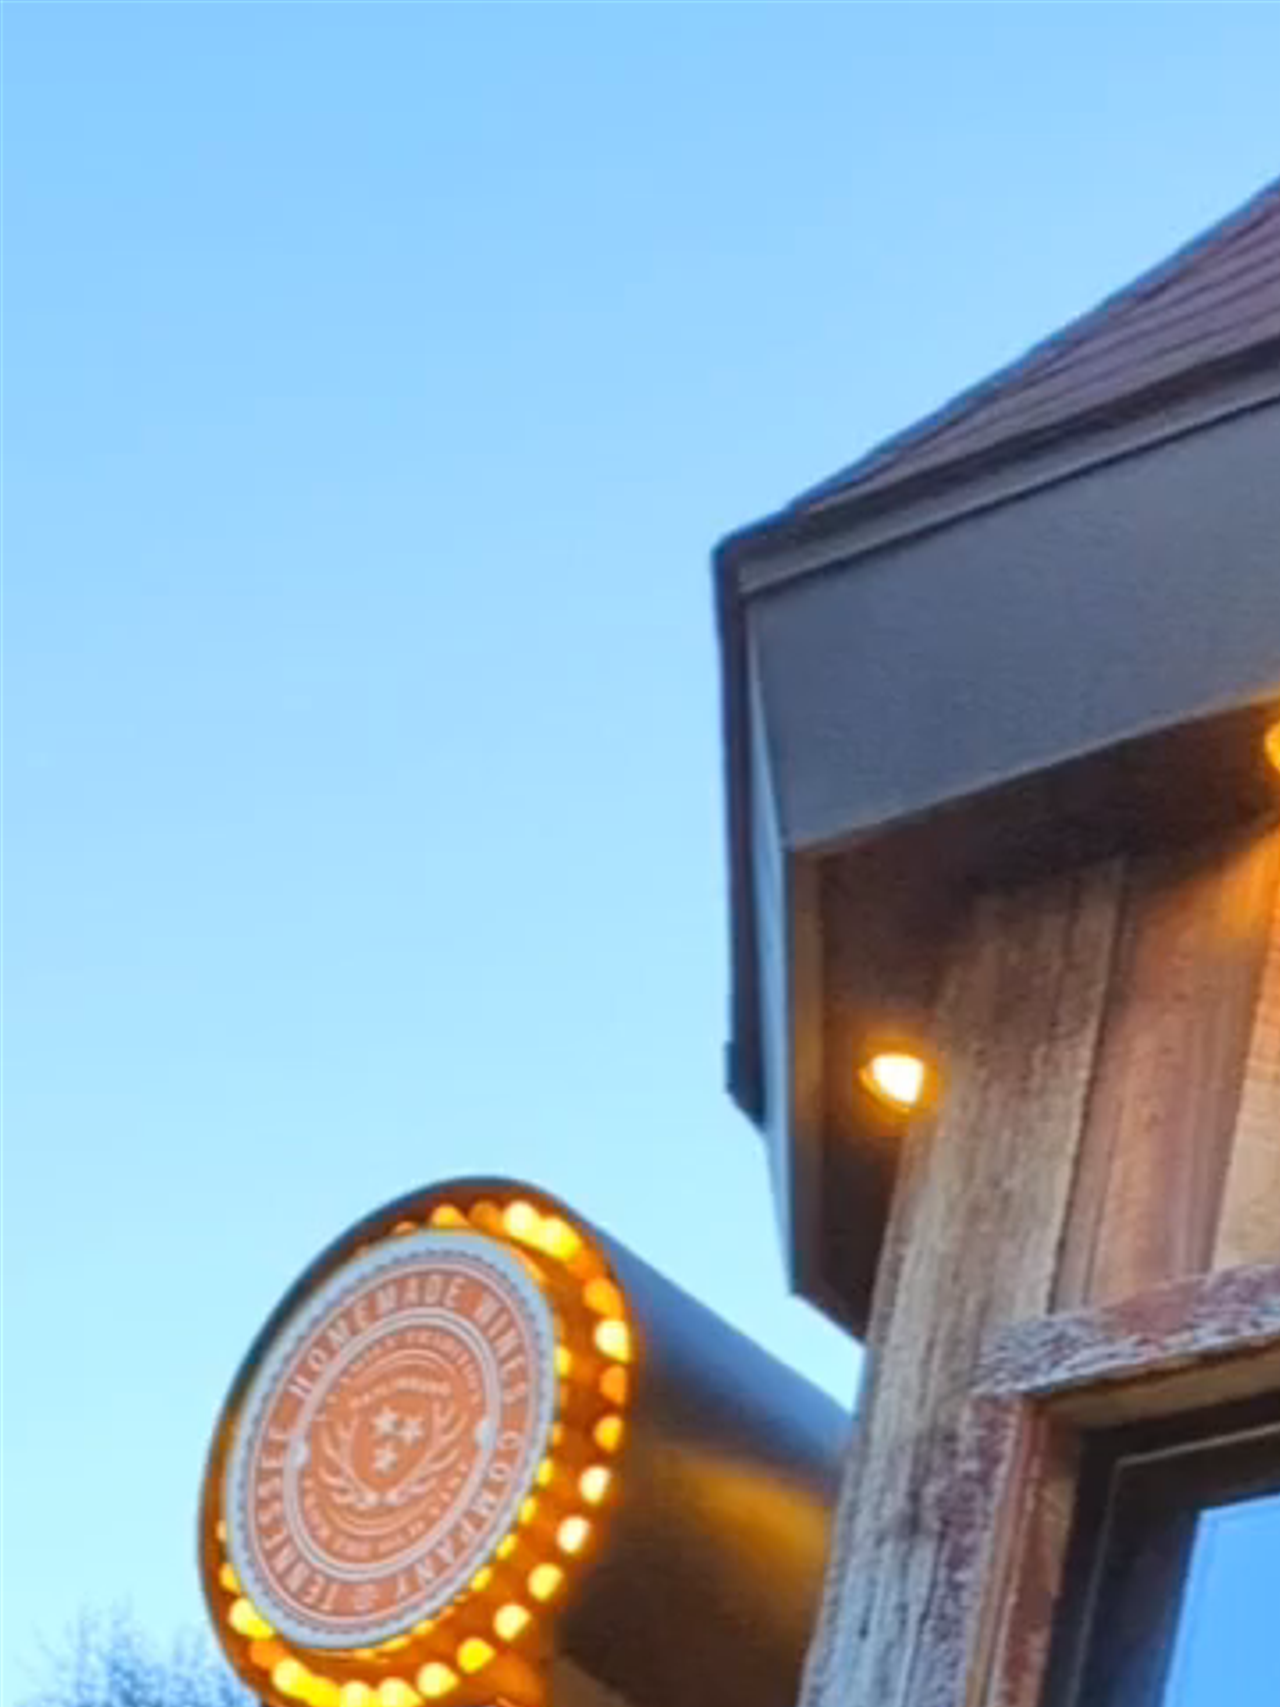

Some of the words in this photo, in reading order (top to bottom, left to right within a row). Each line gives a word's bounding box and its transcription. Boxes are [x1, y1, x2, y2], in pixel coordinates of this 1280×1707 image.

[288, 1272, 467, 1400] HOMEMADE
[472, 1294, 531, 1406] WINES
[256, 1420, 338, 1613] TENNESSEE
